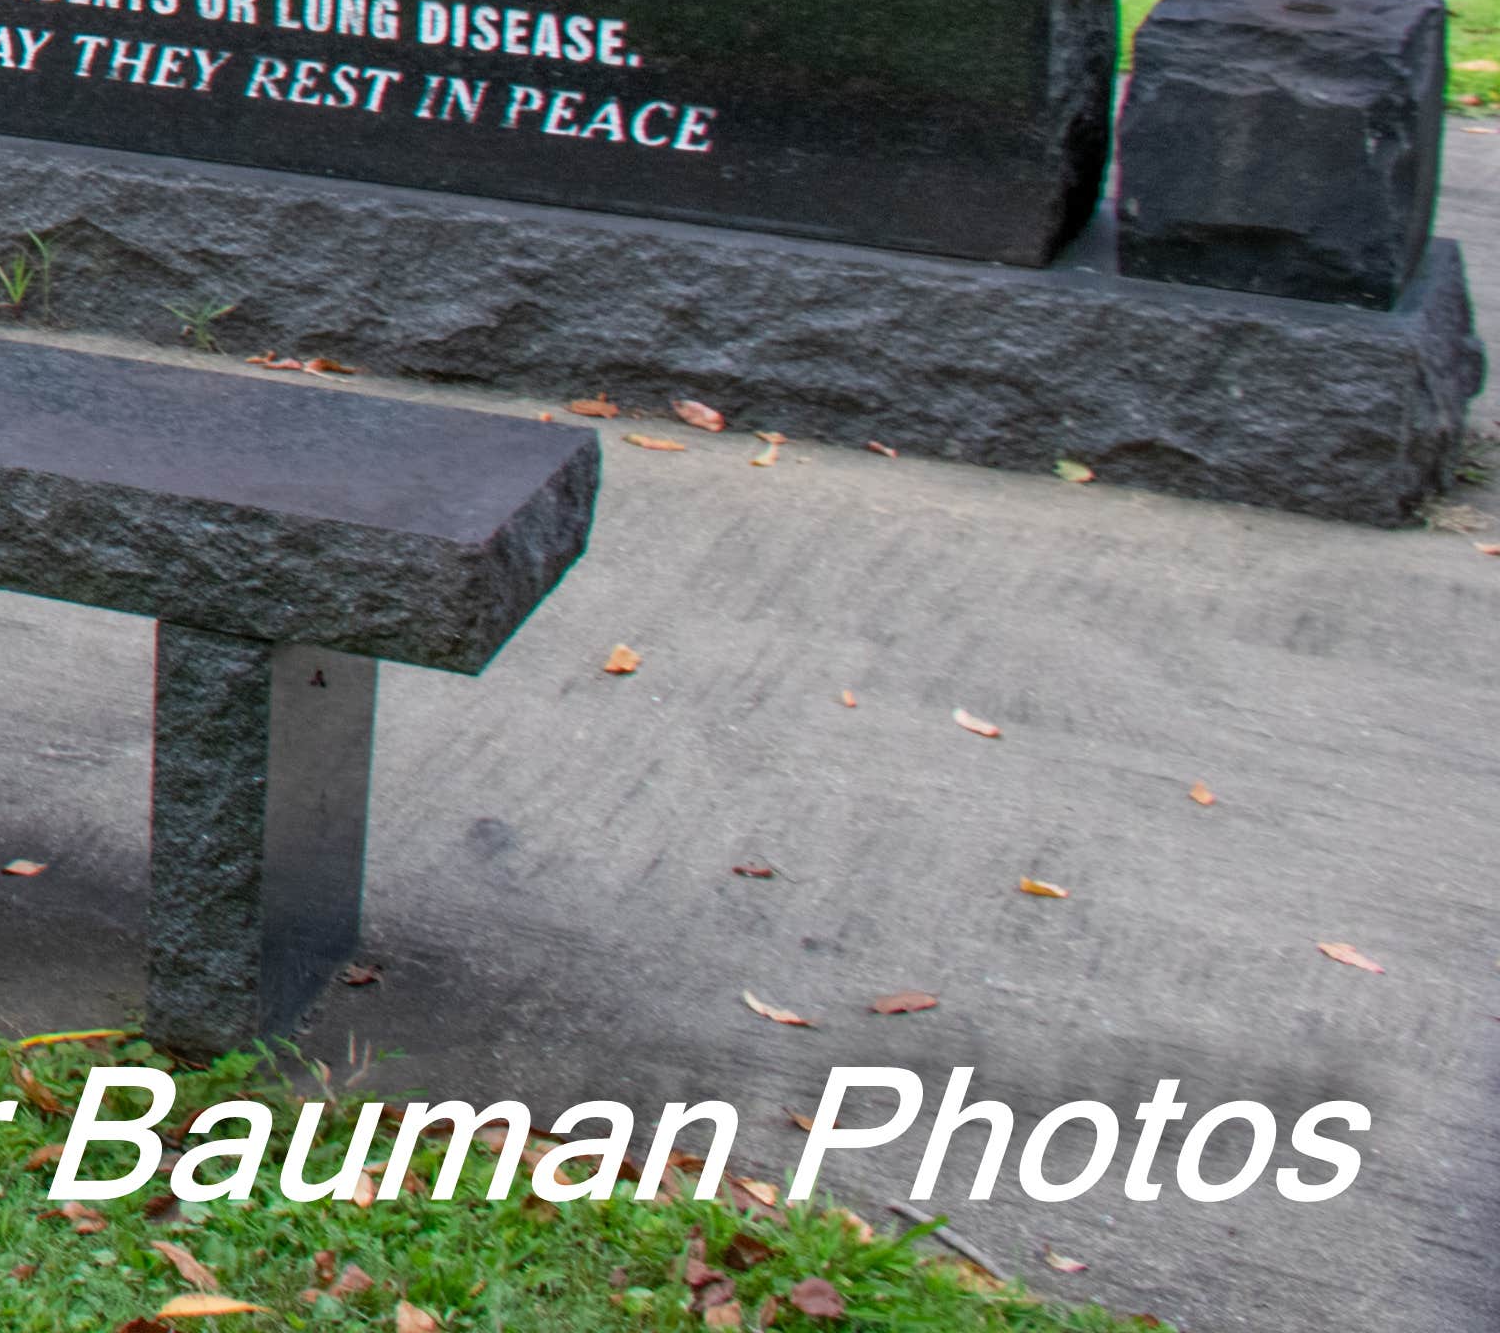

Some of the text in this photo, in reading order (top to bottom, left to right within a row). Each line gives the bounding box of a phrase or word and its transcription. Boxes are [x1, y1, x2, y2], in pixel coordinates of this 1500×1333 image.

[419, 1, 639, 66] DISEASE.
[75, 35, 230, 90] THEY
[247, 58, 400, 112] REST
[416, 74, 488, 125] IN
[500, 83, 719, 153] PEACE
